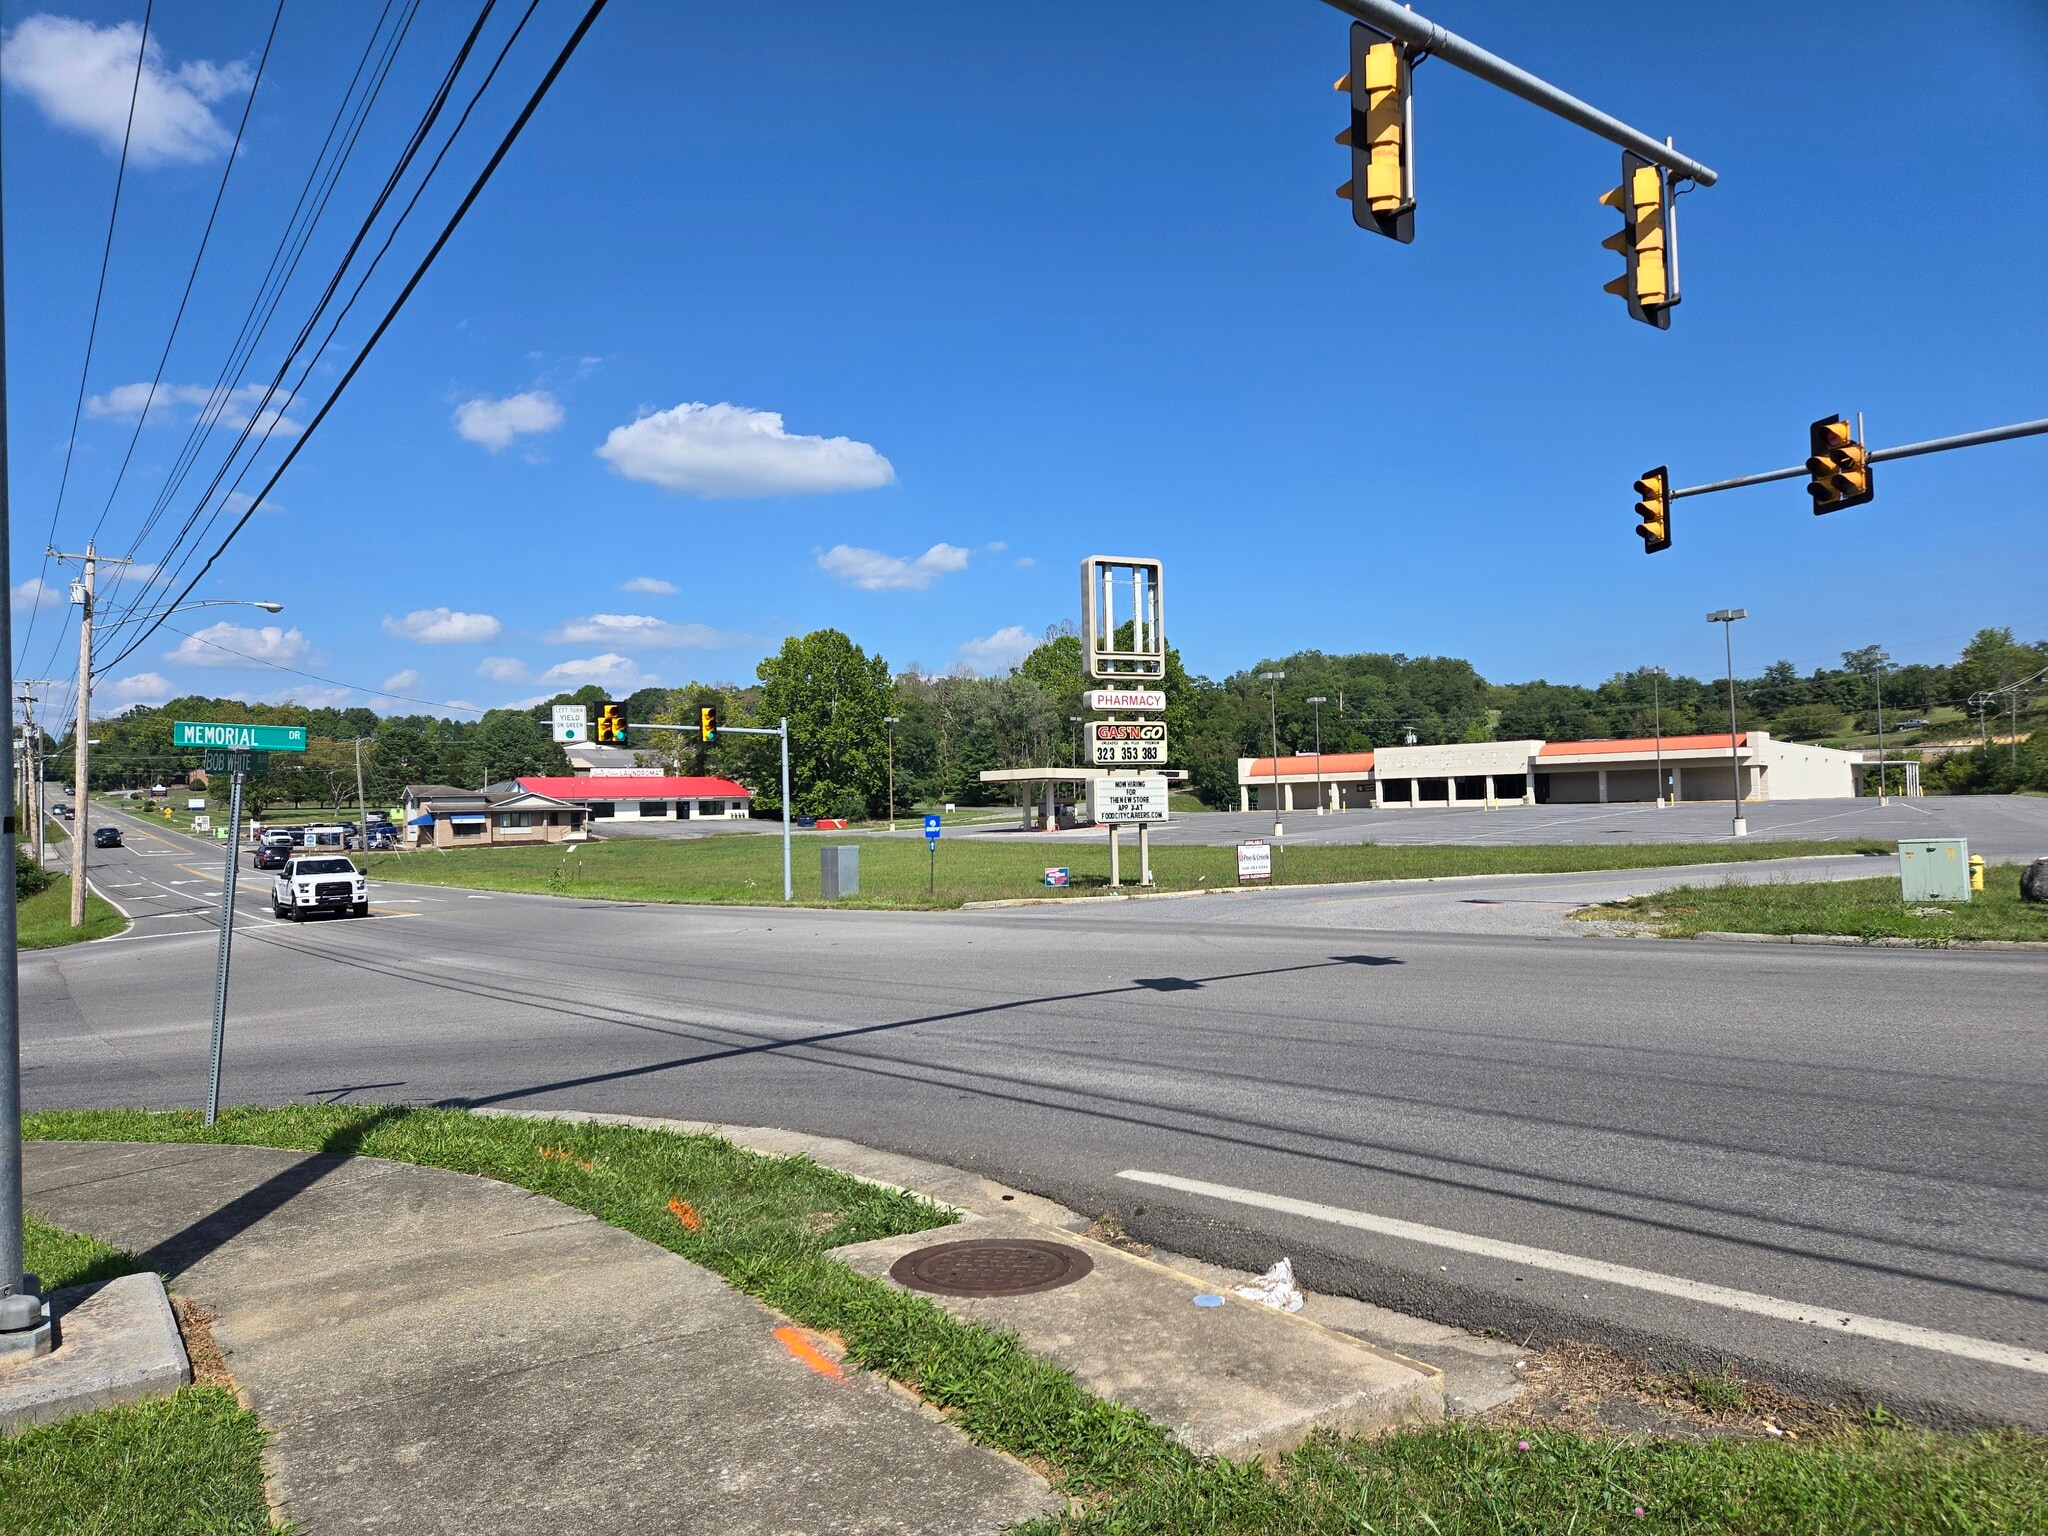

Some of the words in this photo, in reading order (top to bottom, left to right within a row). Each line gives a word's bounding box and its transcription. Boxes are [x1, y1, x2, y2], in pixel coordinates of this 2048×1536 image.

[1097, 695, 1161, 706] PHARMACY
[184, 726, 259, 746] MEMORIAL
[288, 730, 301, 740] DR
[1140, 726, 1163, 740] GO
[1097, 747, 1115, 760] 323
[1121, 747, 1138, 760] 353
[1142, 747, 1158, 760] 383
[206, 753, 225, 771] BOB
[227, 754, 251, 771] WHITE
